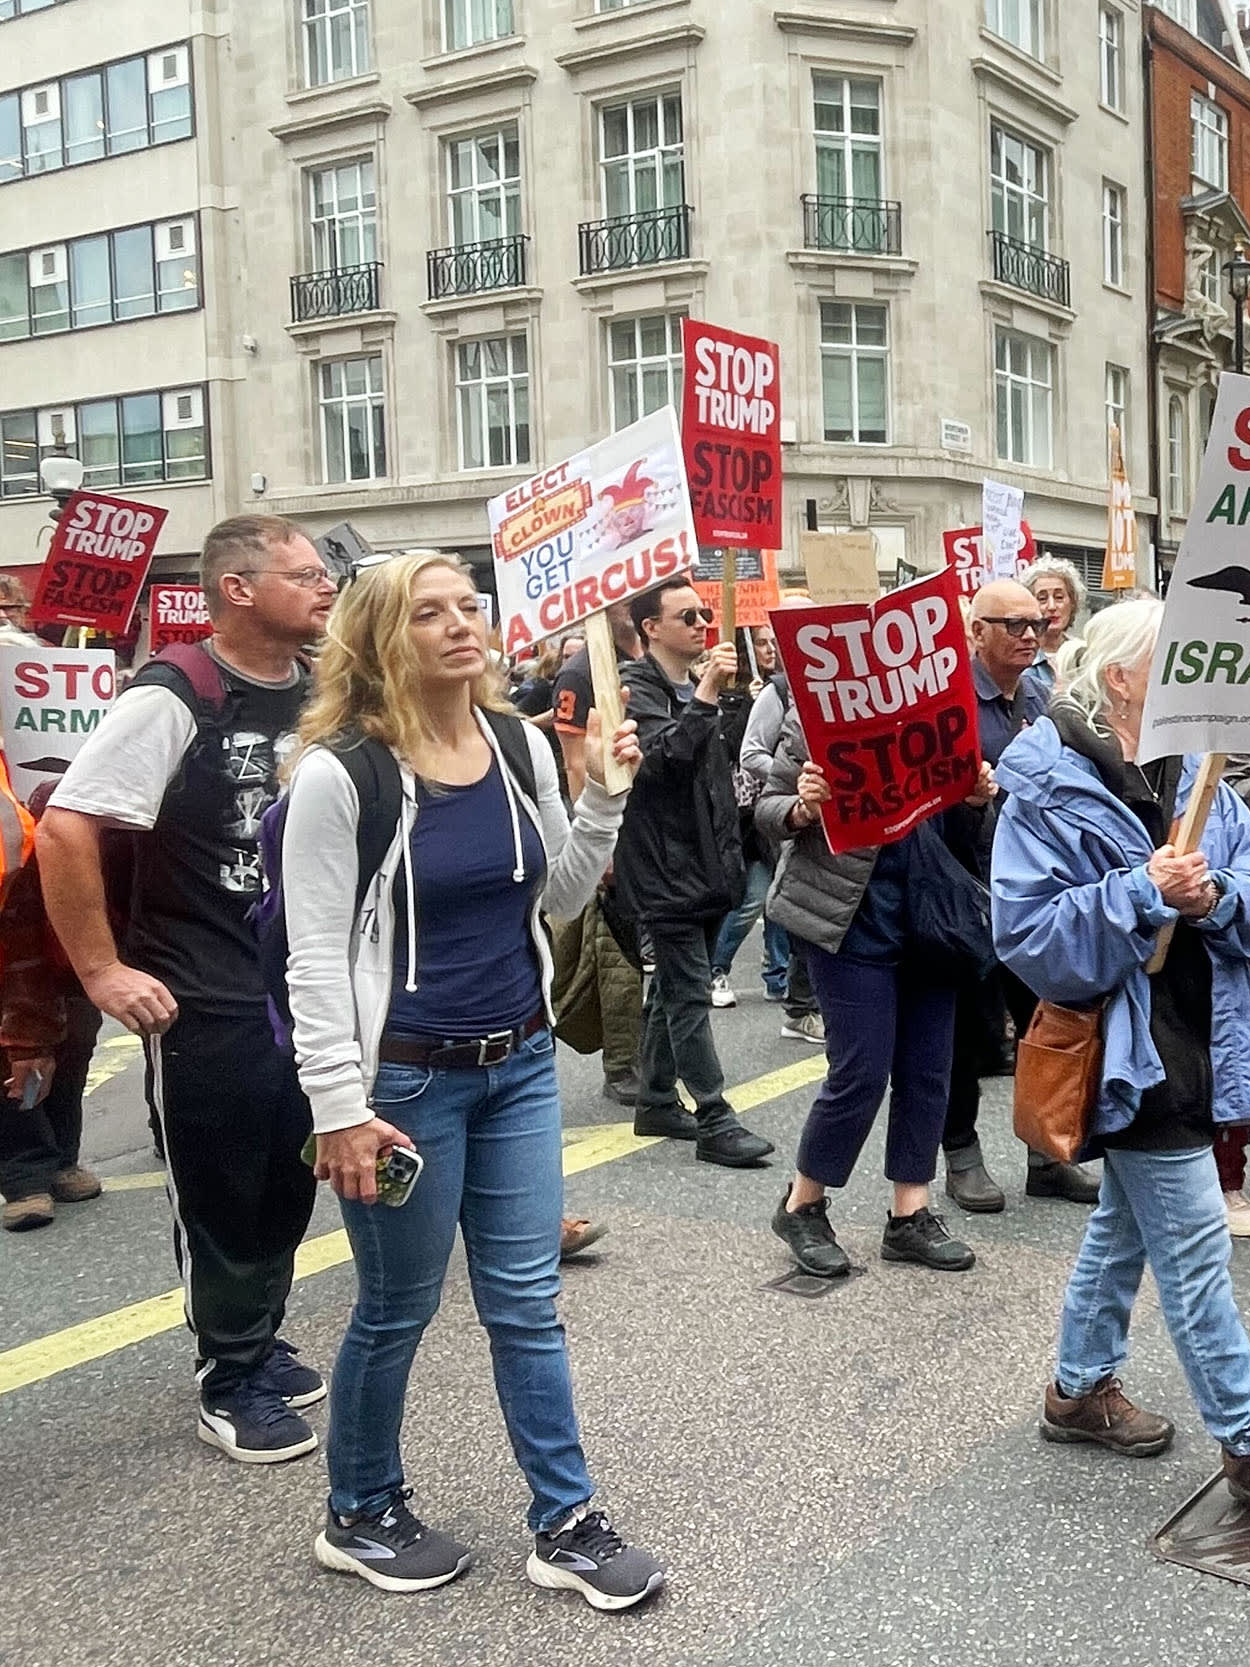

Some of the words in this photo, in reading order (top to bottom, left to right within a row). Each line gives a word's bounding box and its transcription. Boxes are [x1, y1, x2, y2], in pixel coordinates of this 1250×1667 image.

[695, 337, 774, 398] STOP
[695, 385, 775, 435] TRUMP
[505, 461, 570, 512] ELECT
[691, 440, 773, 494] STOP
[69, 500, 154, 539] STOP
[511, 501, 577, 548] CLOWN
[692, 489, 774, 526] FASCISM
[64, 527, 146, 562] TRUMP
[520, 531, 574, 577] YOU
[47, 560, 133, 596] STOP
[506, 613, 533, 655] A
[539, 531, 690, 631] CIRCUS!
[526, 557, 573, 600] GET
[796, 596, 949, 680] STOP
[14, 662, 115, 700] STO
[807, 646, 958, 723] TRUMP
[826, 705, 969, 792] STOP
[837, 749, 977, 824] FASCISM
